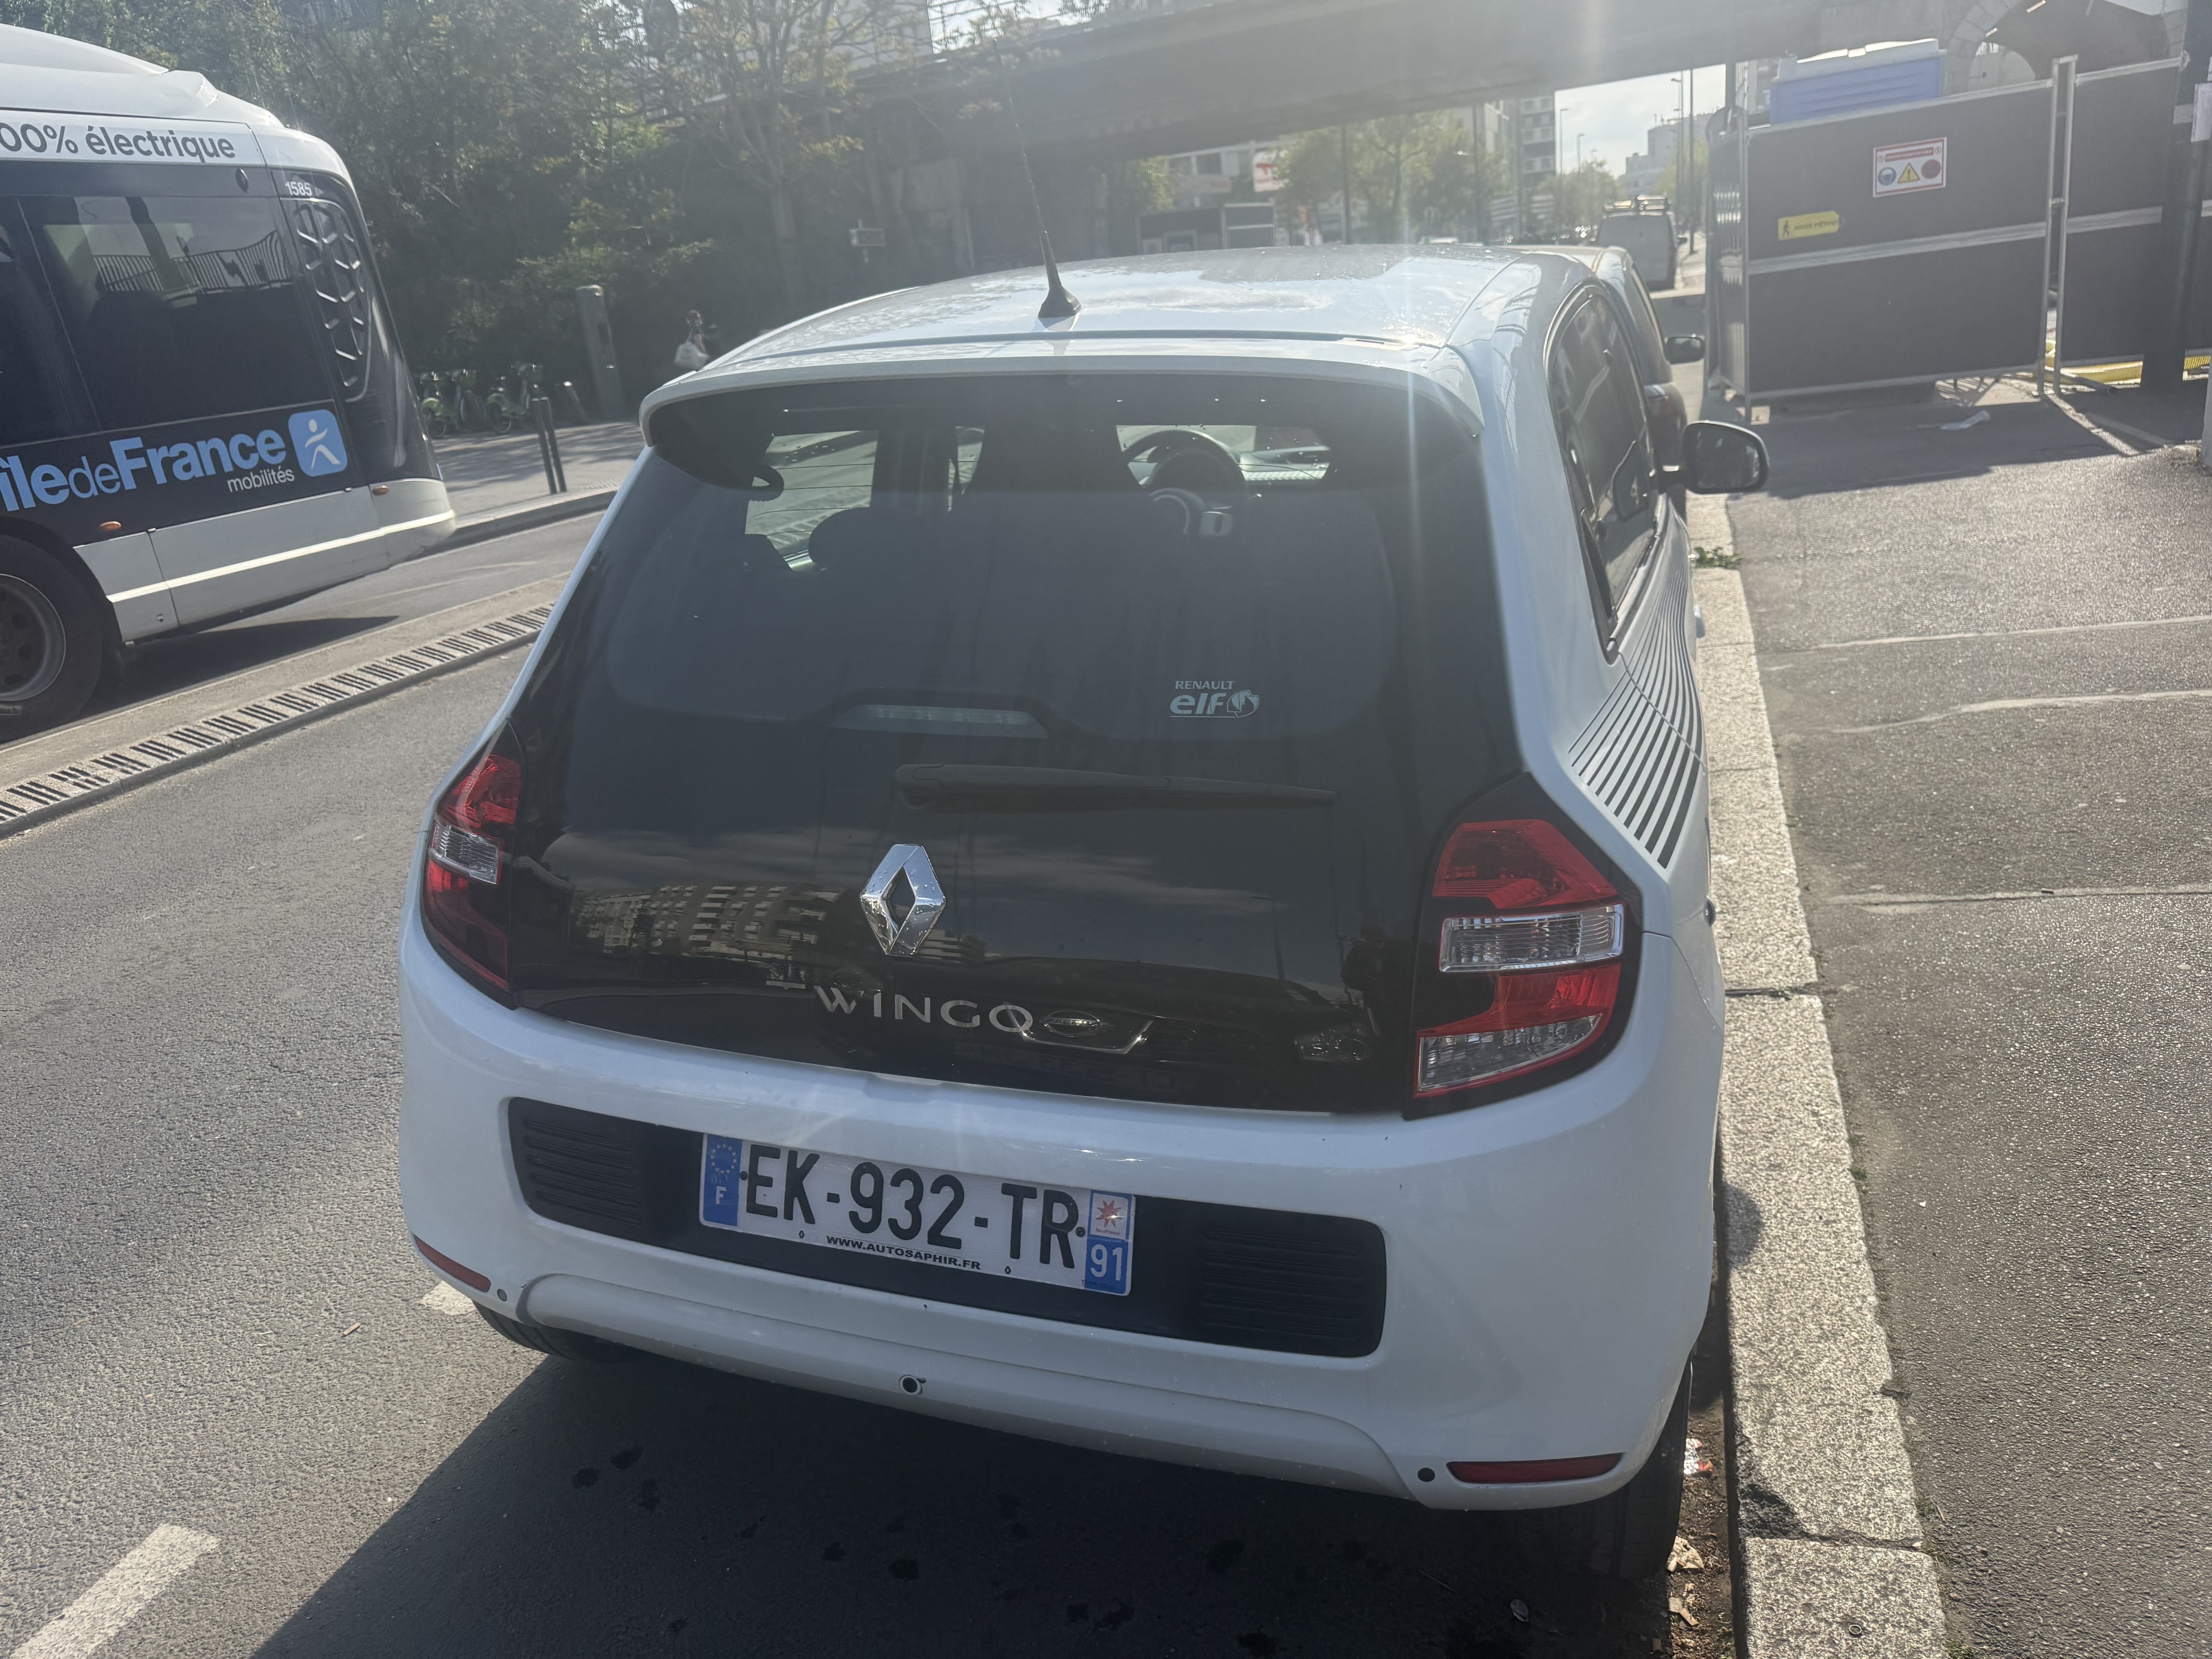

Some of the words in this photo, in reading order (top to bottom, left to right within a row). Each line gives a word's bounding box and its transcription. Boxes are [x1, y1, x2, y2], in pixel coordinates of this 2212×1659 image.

[86, 125, 235, 163] électrique
[283, 181, 313, 197] 1585
[227, 465, 295, 493] mobilités
[1175, 680, 1236, 690] RENAULT
[1170, 692, 1226, 714] elf
[714, 1185, 726, 1205] F
[746, 1144, 1079, 1269] EK-932-TR
[826, 1235, 981, 1271] WWW.AUTOSAPHIR.FR
[1090, 1243, 1123, 1281] 91
